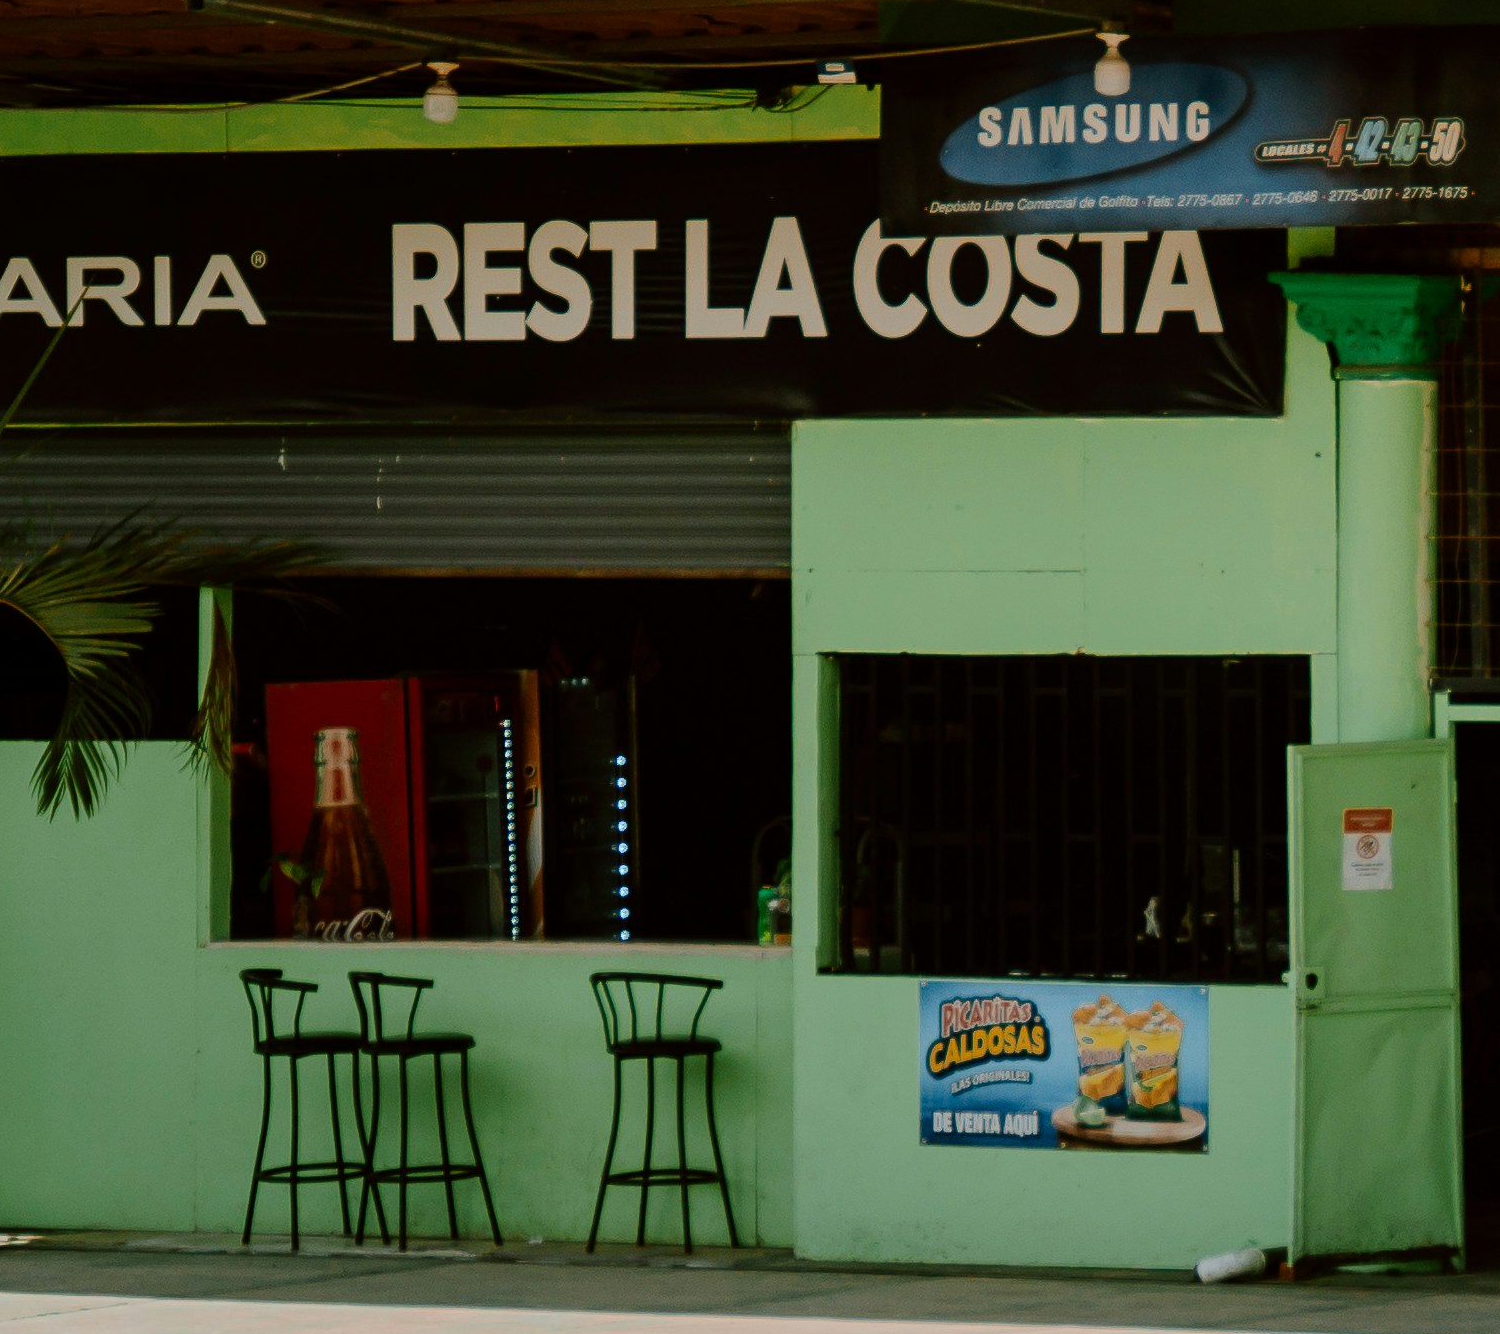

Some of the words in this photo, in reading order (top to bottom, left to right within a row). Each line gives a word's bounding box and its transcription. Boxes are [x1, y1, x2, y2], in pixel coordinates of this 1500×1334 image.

[976, 100, 1211, 148] SAMSUNG
[1262, 142, 1315, 157] LOCALES
[929, 200, 981, 215] Depósito
[984, 199, 1014, 212] Libre
[1016, 197, 1078, 211] Comercial
[1079, 196, 1095, 210] de
[1098, 195, 1139, 208] Golfito
[1328, 187, 1393, 202] 2775-0017
[1402, 186, 1469, 200] 2775-1675
[391, 219, 658, 342] REST
[684, 216, 828, 340] LA
[852, 218, 1224, 339] COSTA
[929, 1023, 1045, 1073] CALDOSAS
[932, 1110, 953, 1134] DE
[955, 1111, 1001, 1135] VENTA
